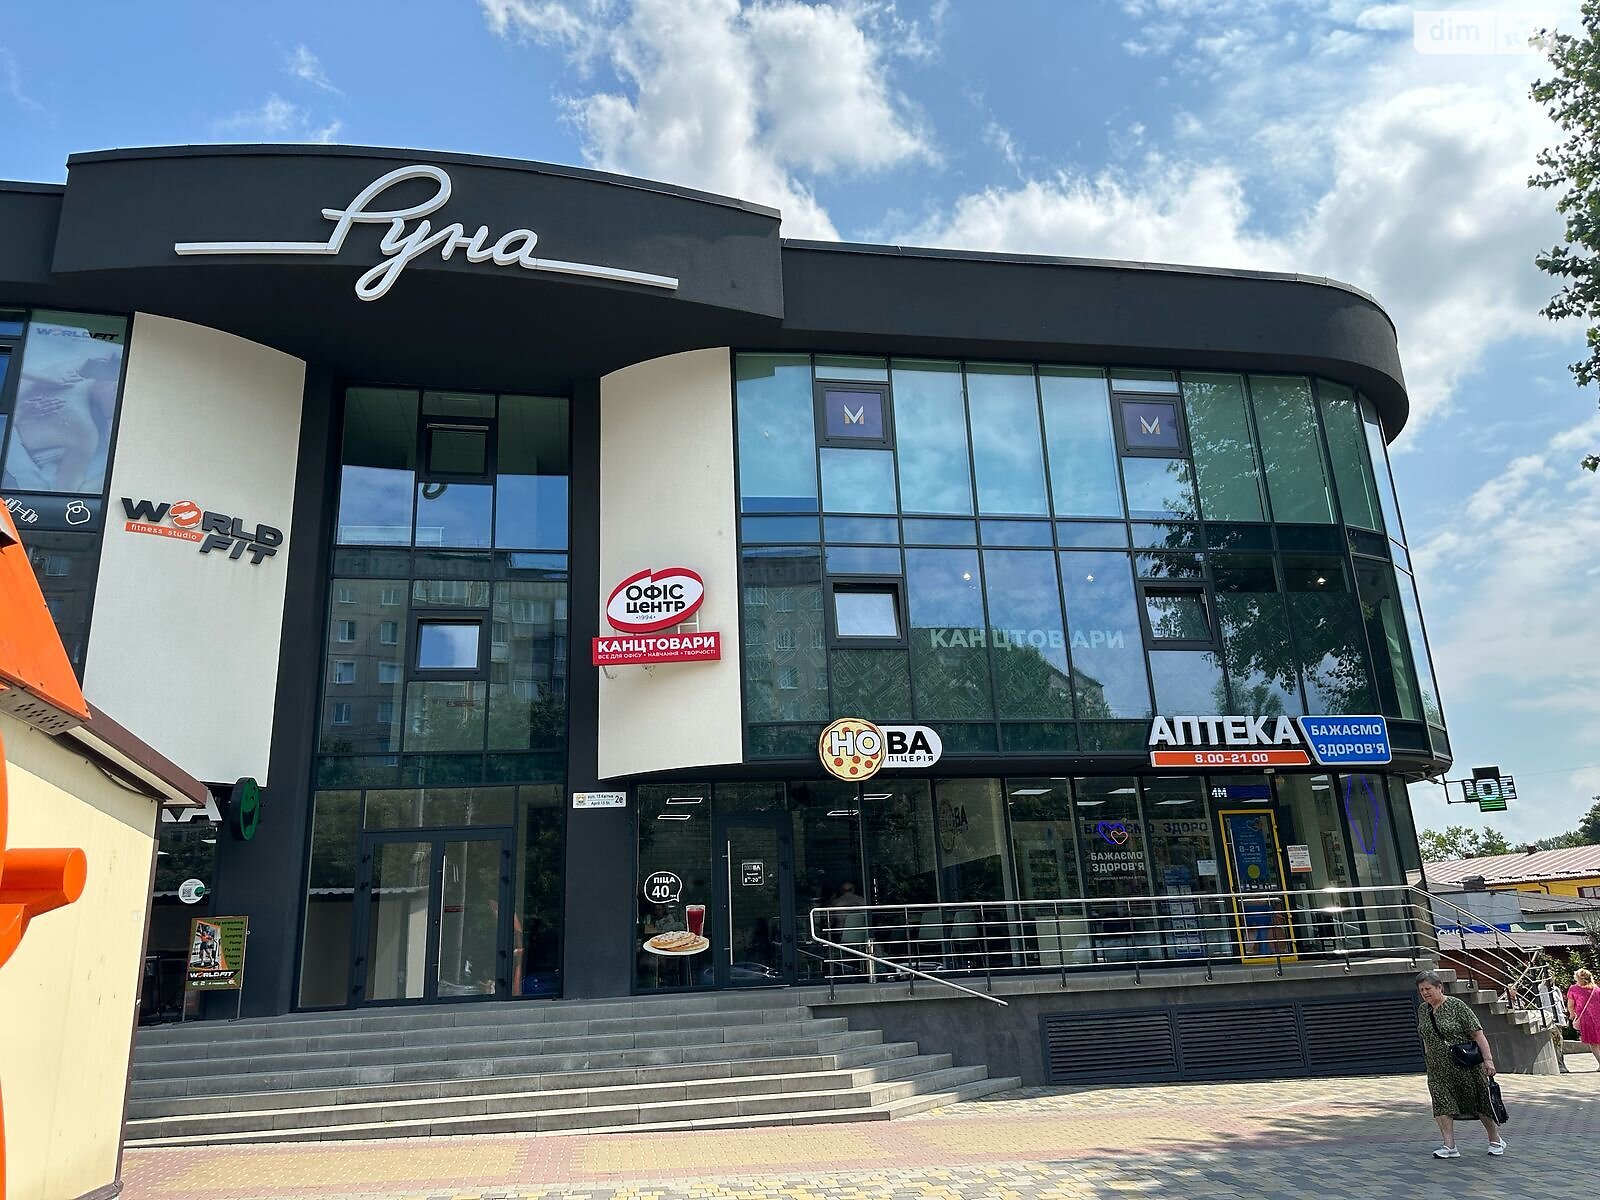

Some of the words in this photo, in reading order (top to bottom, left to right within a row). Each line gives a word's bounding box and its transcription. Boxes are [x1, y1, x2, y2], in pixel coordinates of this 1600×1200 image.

[120, 497, 284, 547] WORLD
[131, 523, 163, 535] fitness
[168, 530, 197, 541] studio
[199, 533, 278, 565] FIT
[626, 584, 684, 600] ОФІС
[597, 636, 716, 653] КАНЦТОВАРИ
[929, 629, 1125, 651] КАНЦТОВАРИ
[1149, 715, 1301, 746] АПТЕКА
[1311, 723, 1382, 736] БАЖАЄМО
[831, 730, 934, 756] НОВА
[1090, 851, 1143, 861] БАЖАЄМО
[653, 876, 676, 885] ПІЦА
[651, 885, 670, 898] 40
